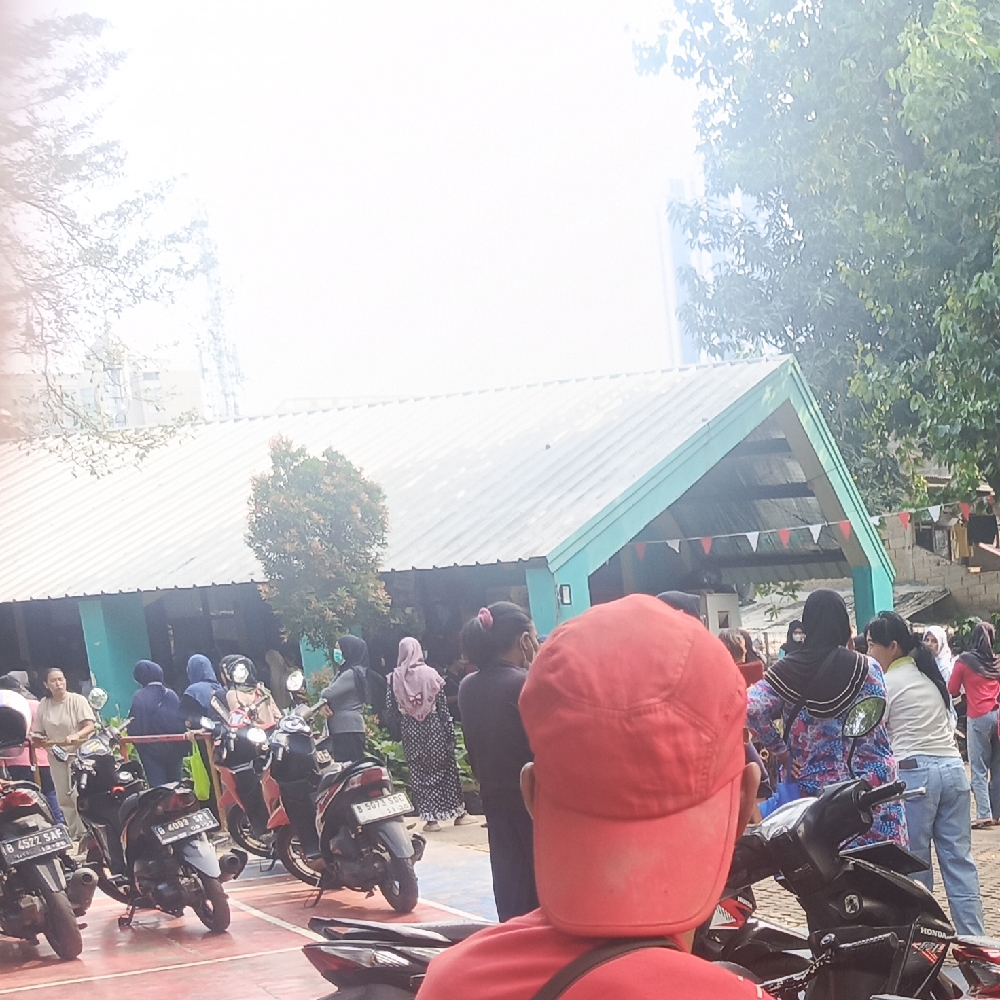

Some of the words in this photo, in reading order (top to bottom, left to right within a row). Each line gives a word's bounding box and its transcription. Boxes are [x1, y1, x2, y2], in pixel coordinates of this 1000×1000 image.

[5, 843, 14, 854] B
[17, 835, 42, 850] 4522
[42, 829, 63, 842] SAF
[920, 926, 947, 939] HONDA
